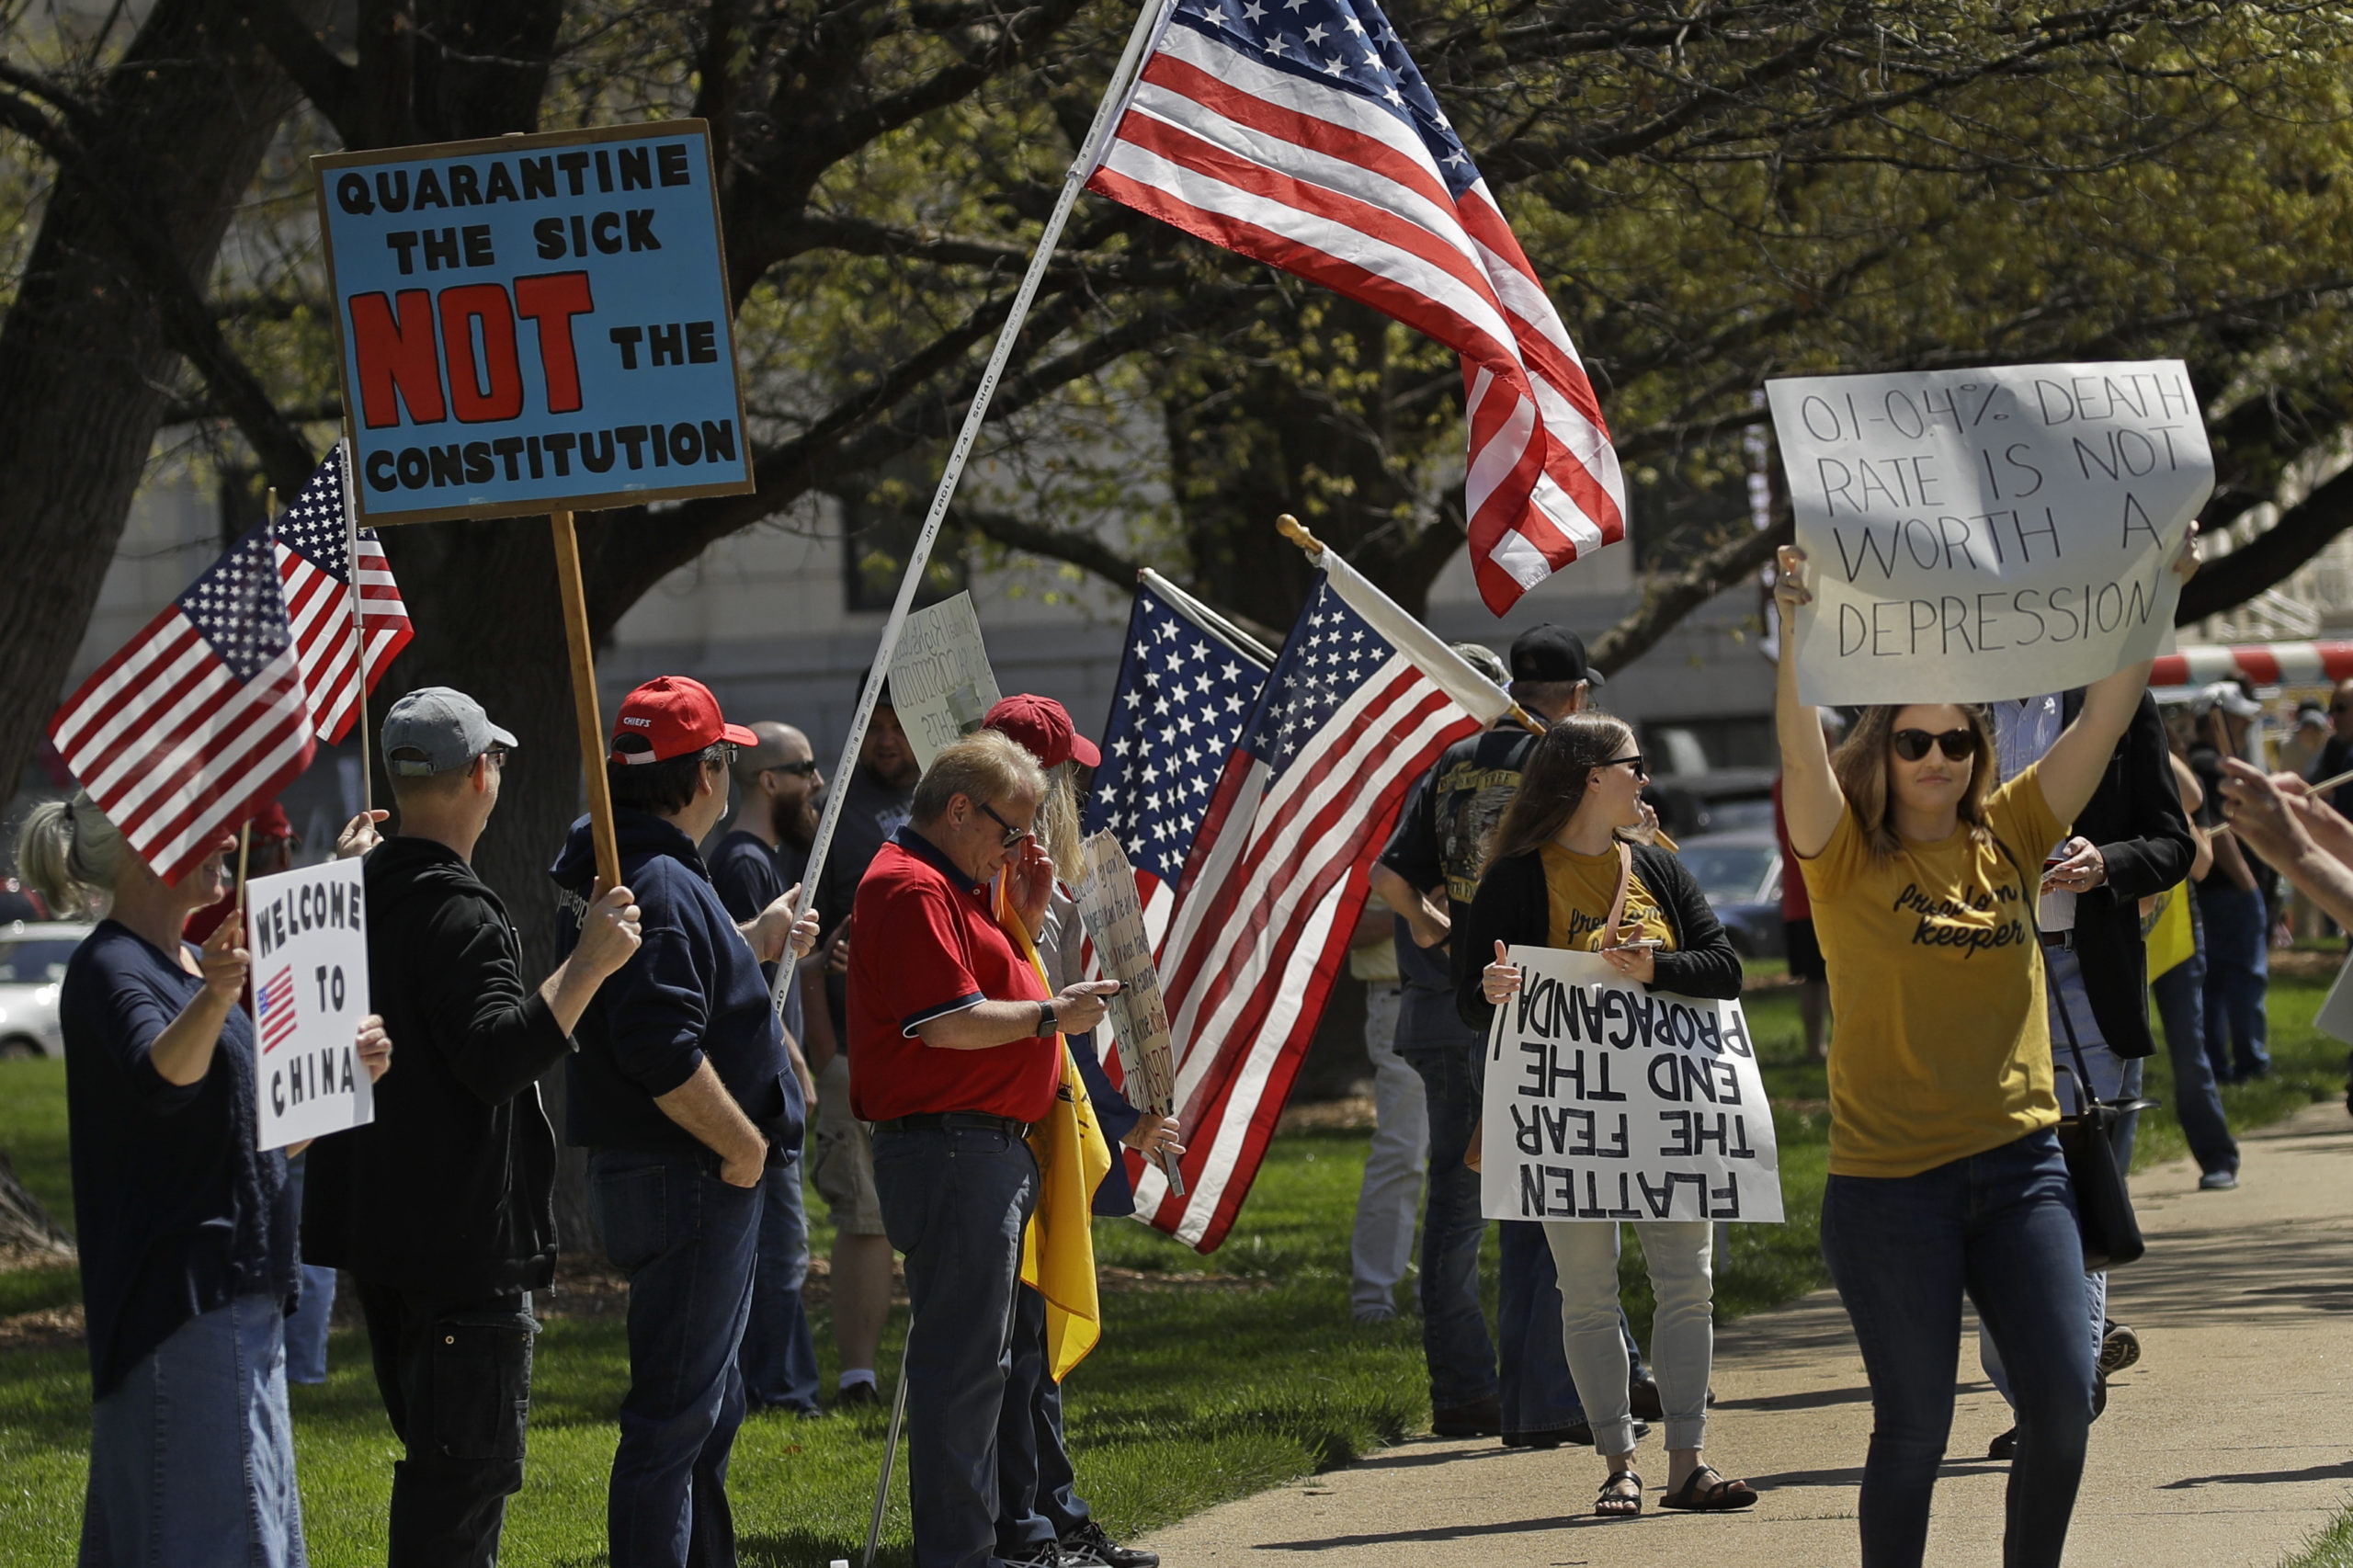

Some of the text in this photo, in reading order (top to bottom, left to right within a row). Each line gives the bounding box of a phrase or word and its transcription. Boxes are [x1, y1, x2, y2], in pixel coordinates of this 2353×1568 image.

[336, 143, 690, 215] QUARANTINE
[386, 209, 661, 275] THE SICK
[348, 270, 717, 429] NOT THE
[2035, 374, 2188, 426] DEATH
[366, 419, 735, 492] CONSTITUTION
[933, 472, 954, 516] EAGLE
[972, 373, 994, 418] SCH40
[1817, 426, 2184, 517] RATE IS NOT
[1834, 492, 2162, 582] WORTH A
[1840, 568, 2162, 657] DEPRESSION
[623, 717, 652, 728] CHIEFS
[1485, 772, 1512, 789] FREE
[256, 881, 361, 959] WELCOME
[1912, 915, 2025, 960] keeper
[315, 965, 345, 1012] TO
[270, 1047, 355, 1118] CHINA
[1518, 1041, 1743, 1106] END THE
[1510, 1103, 1756, 1158] THE FEAR
[1520, 1164, 1740, 1219] FLATTEN
